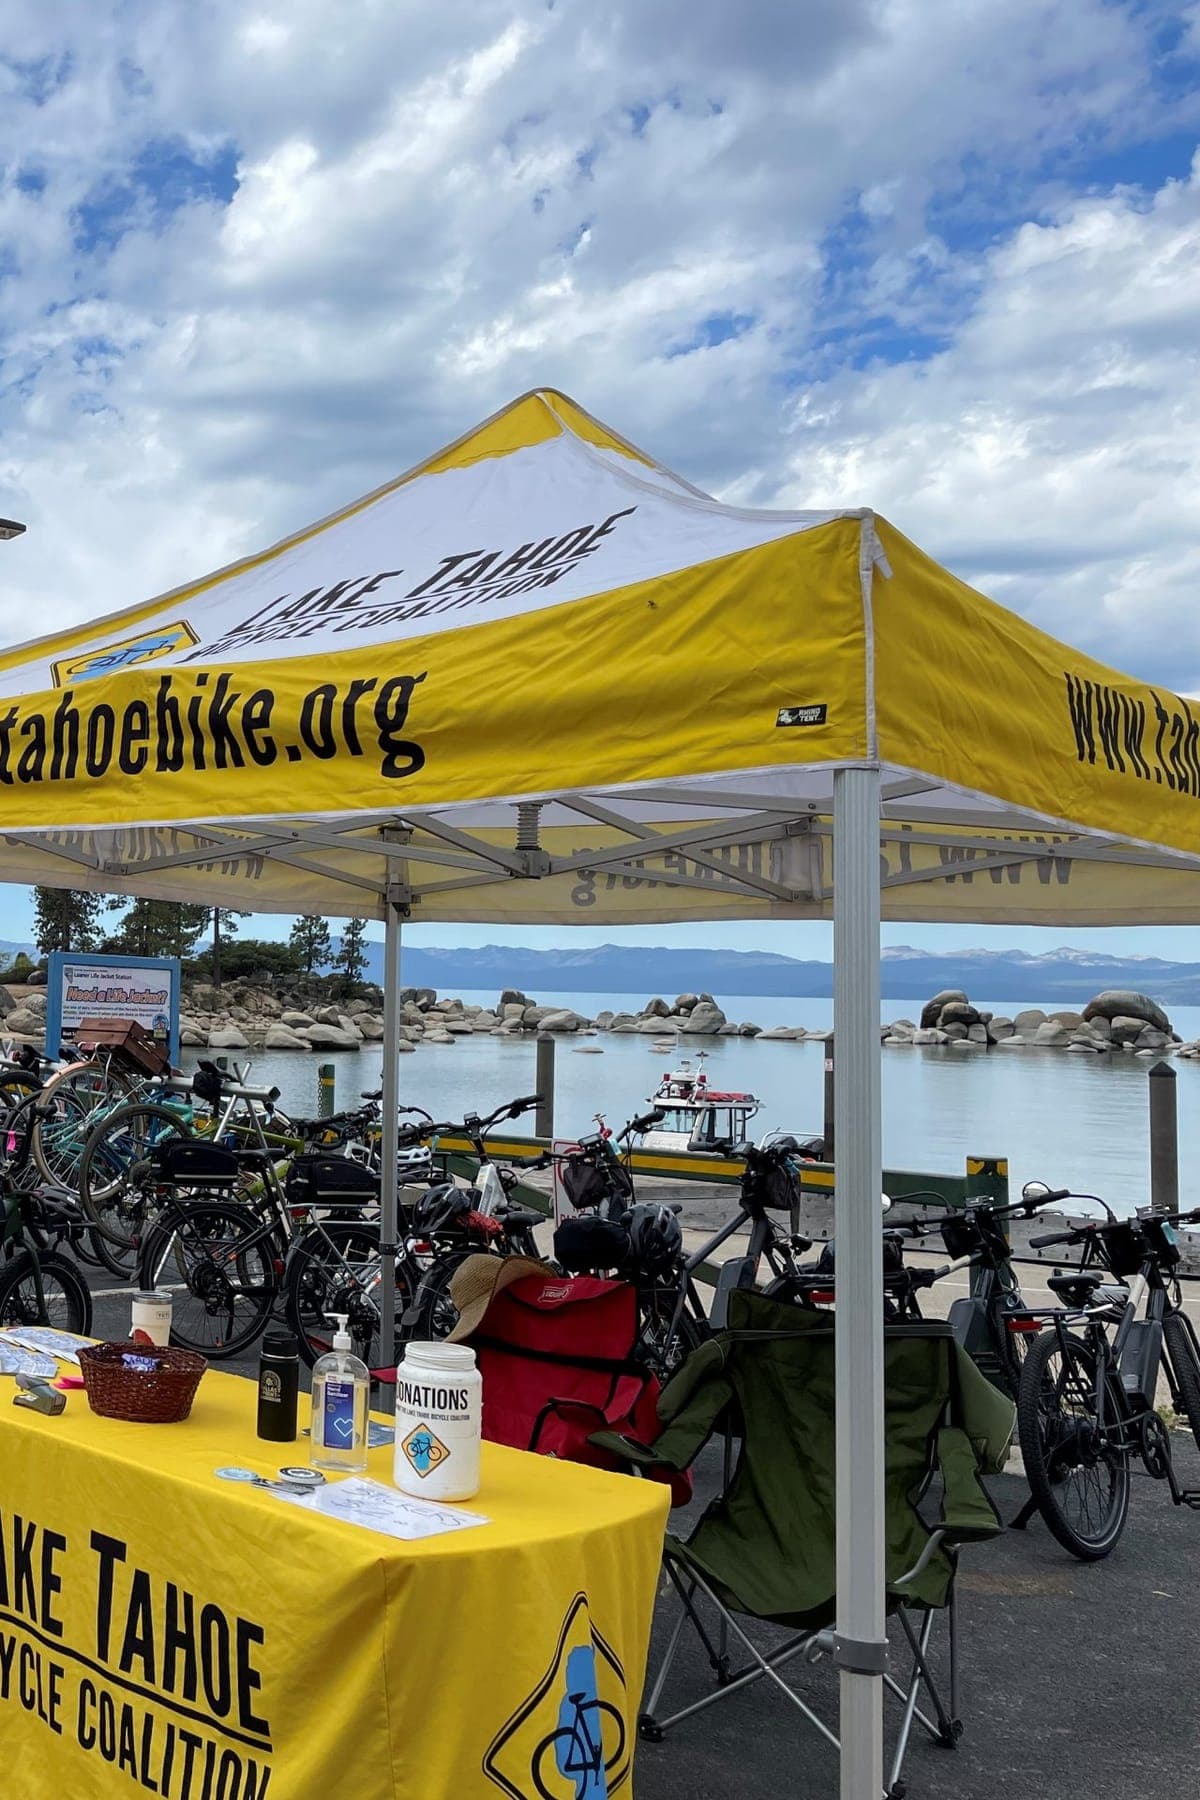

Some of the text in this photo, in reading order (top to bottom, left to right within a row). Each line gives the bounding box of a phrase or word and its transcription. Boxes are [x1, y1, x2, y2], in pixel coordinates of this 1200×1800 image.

[174, 563, 578, 664] BICYCLE COALITION
[225, 505, 638, 636] LAKE TAHOE
[66, 986, 168, 1005] Need a Life Jacket?
[397, 1381, 468, 1411] ONATIONS
[90, 1529, 270, 1737] TAHOE
[78, 1678, 271, 1800] COALITION
